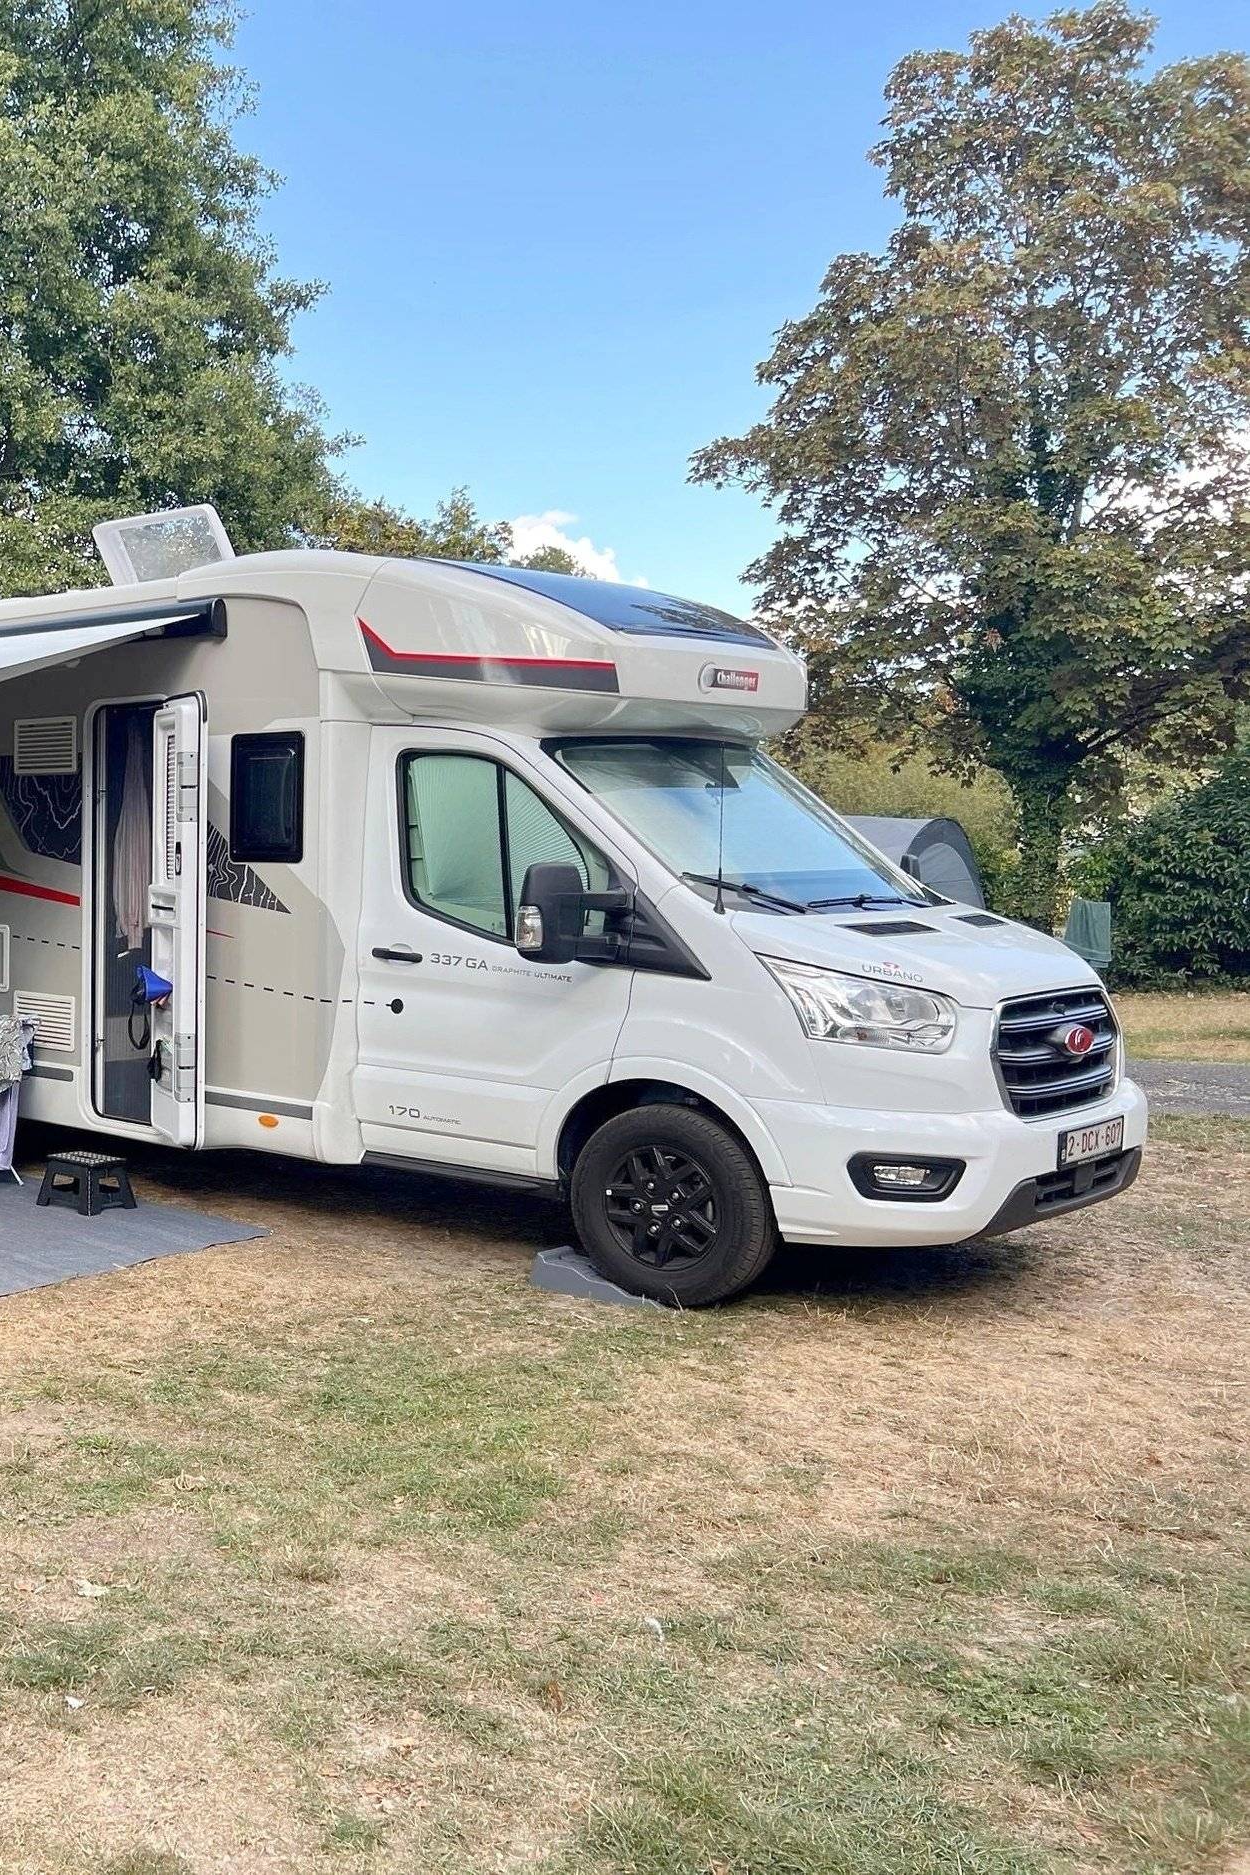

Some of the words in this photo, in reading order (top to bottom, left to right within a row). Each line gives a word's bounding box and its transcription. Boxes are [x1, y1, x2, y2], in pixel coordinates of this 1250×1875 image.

[717, 670, 757, 690] Challenger
[430, 952, 462, 967] 337
[465, 957, 489, 971] GA
[491, 965, 531, 977] GRAPHITE
[534, 972, 573, 983] ULTIMATE
[861, 964, 924, 983] URBANO
[389, 1104, 421, 1118] 170
